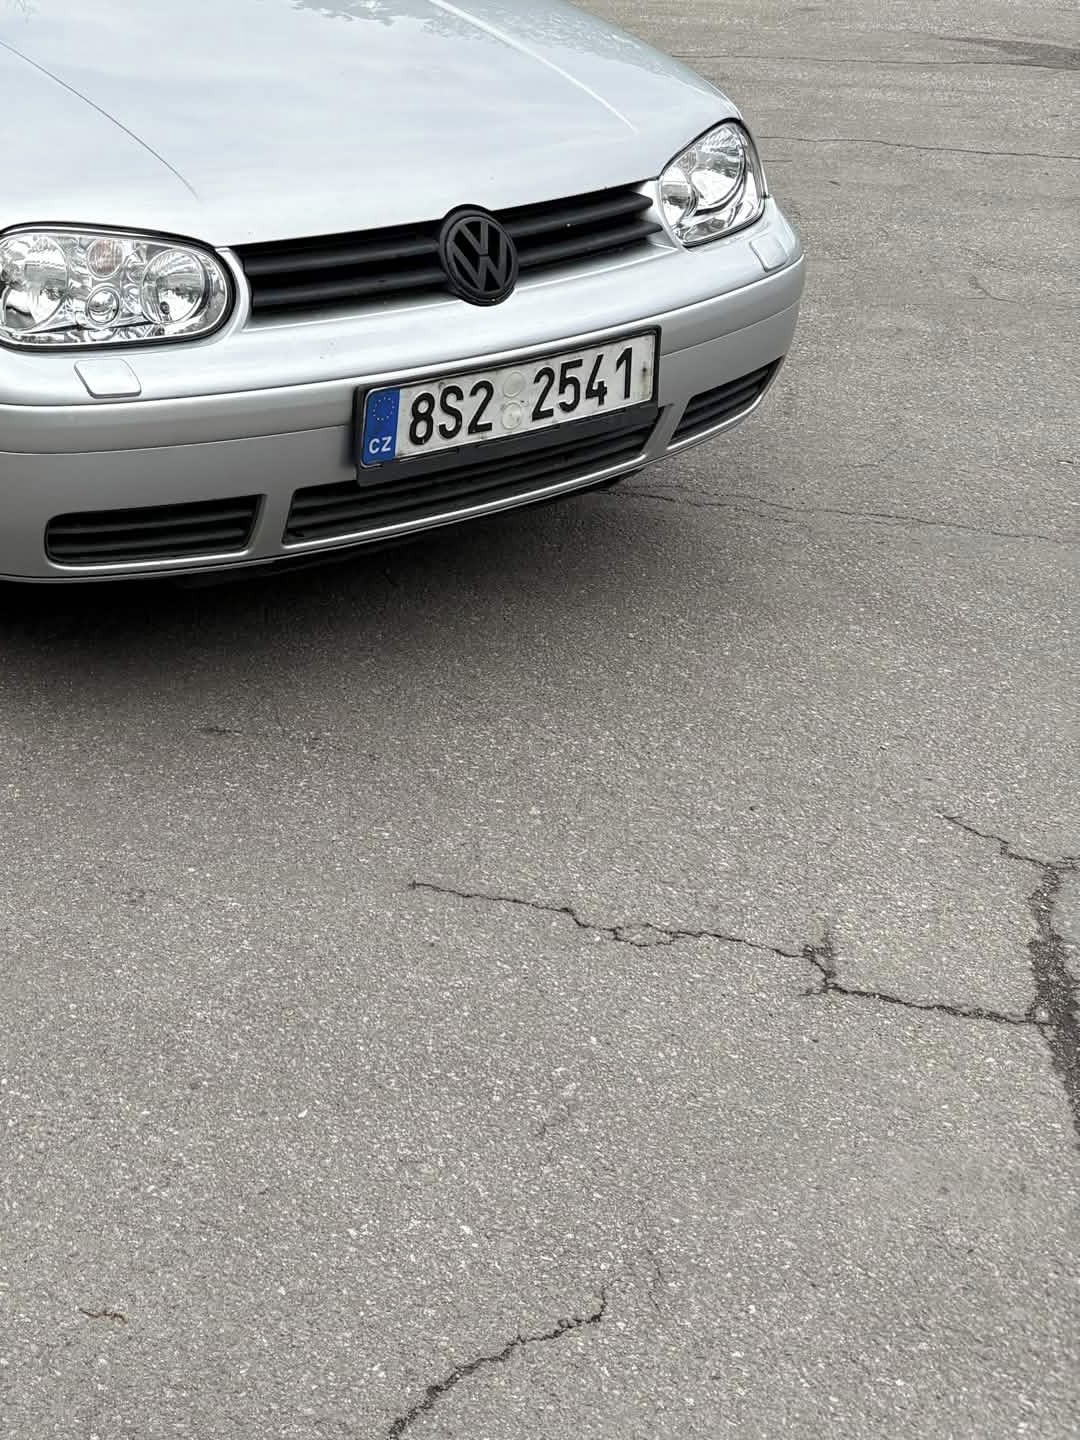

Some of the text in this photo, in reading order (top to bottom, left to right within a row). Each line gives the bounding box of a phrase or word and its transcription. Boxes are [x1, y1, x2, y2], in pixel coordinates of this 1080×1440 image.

[445, 216, 513, 295] VW
[409, 345, 633, 446] 8S2 2541
[368, 436, 392, 454] CZ
